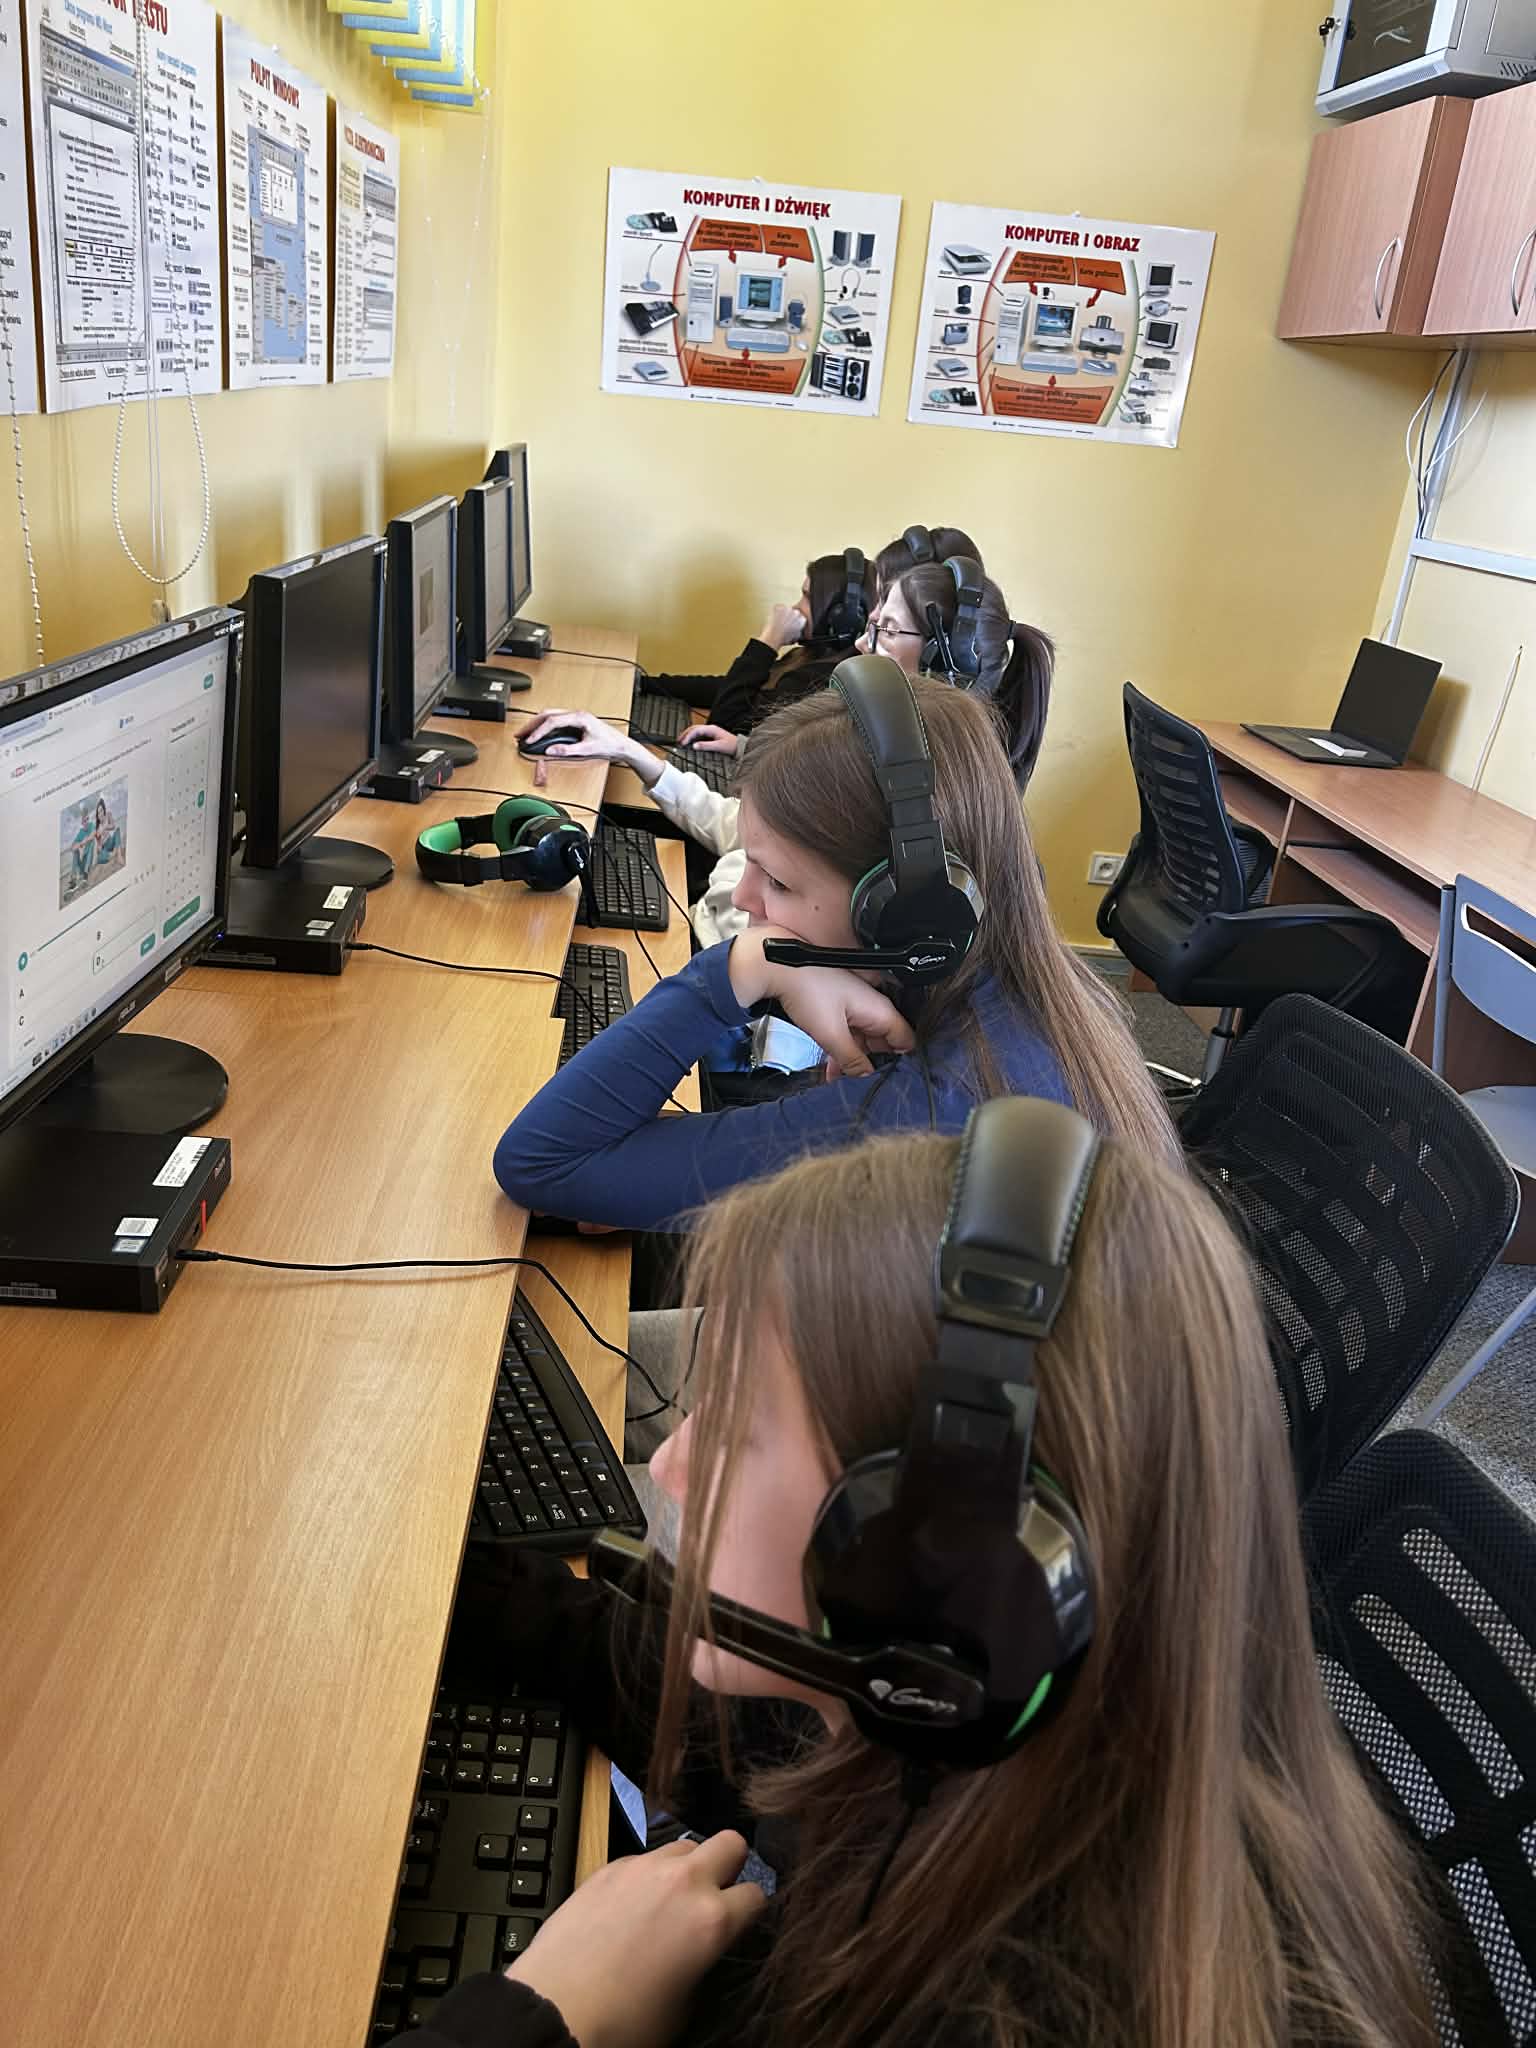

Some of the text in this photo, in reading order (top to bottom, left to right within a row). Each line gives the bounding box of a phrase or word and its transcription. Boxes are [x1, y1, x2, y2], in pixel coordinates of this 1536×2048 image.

[683, 189, 831, 220] KOMPUTER I DŹWIĘK
[1005, 224, 1141, 252] KOMPUTER I OBRAZ
[508, 1933, 517, 1948] Ctrl
